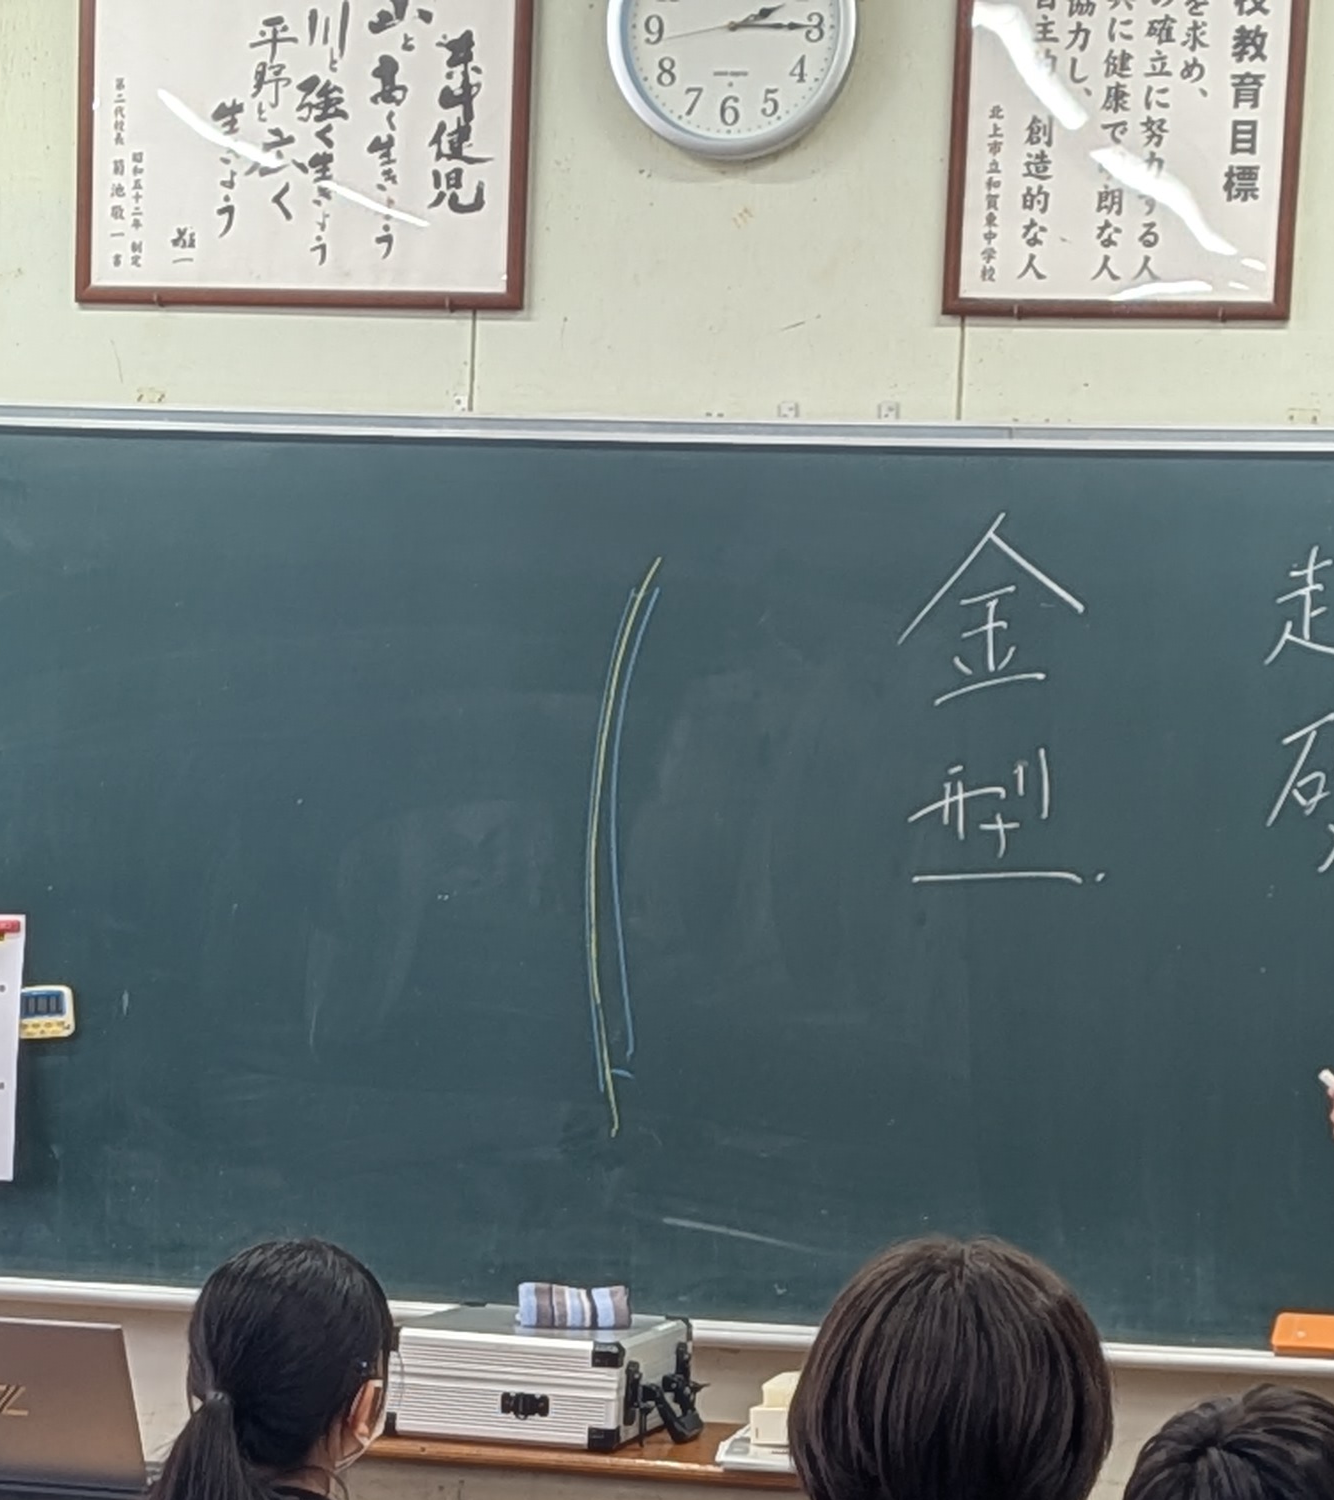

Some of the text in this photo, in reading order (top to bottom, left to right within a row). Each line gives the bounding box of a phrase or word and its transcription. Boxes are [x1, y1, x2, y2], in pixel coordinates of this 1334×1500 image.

[643, 14, 666, 46] 9
[804, 12, 826, 43] 3
[656, 56, 677, 88] 8
[788, 53, 808, 84] 4
[684, 86, 704, 117] 7
[719, 95, 740, 127] 6
[760, 87, 780, 118] 5
[980, 105, 1005, 283] 北上市立和賀東中学校
